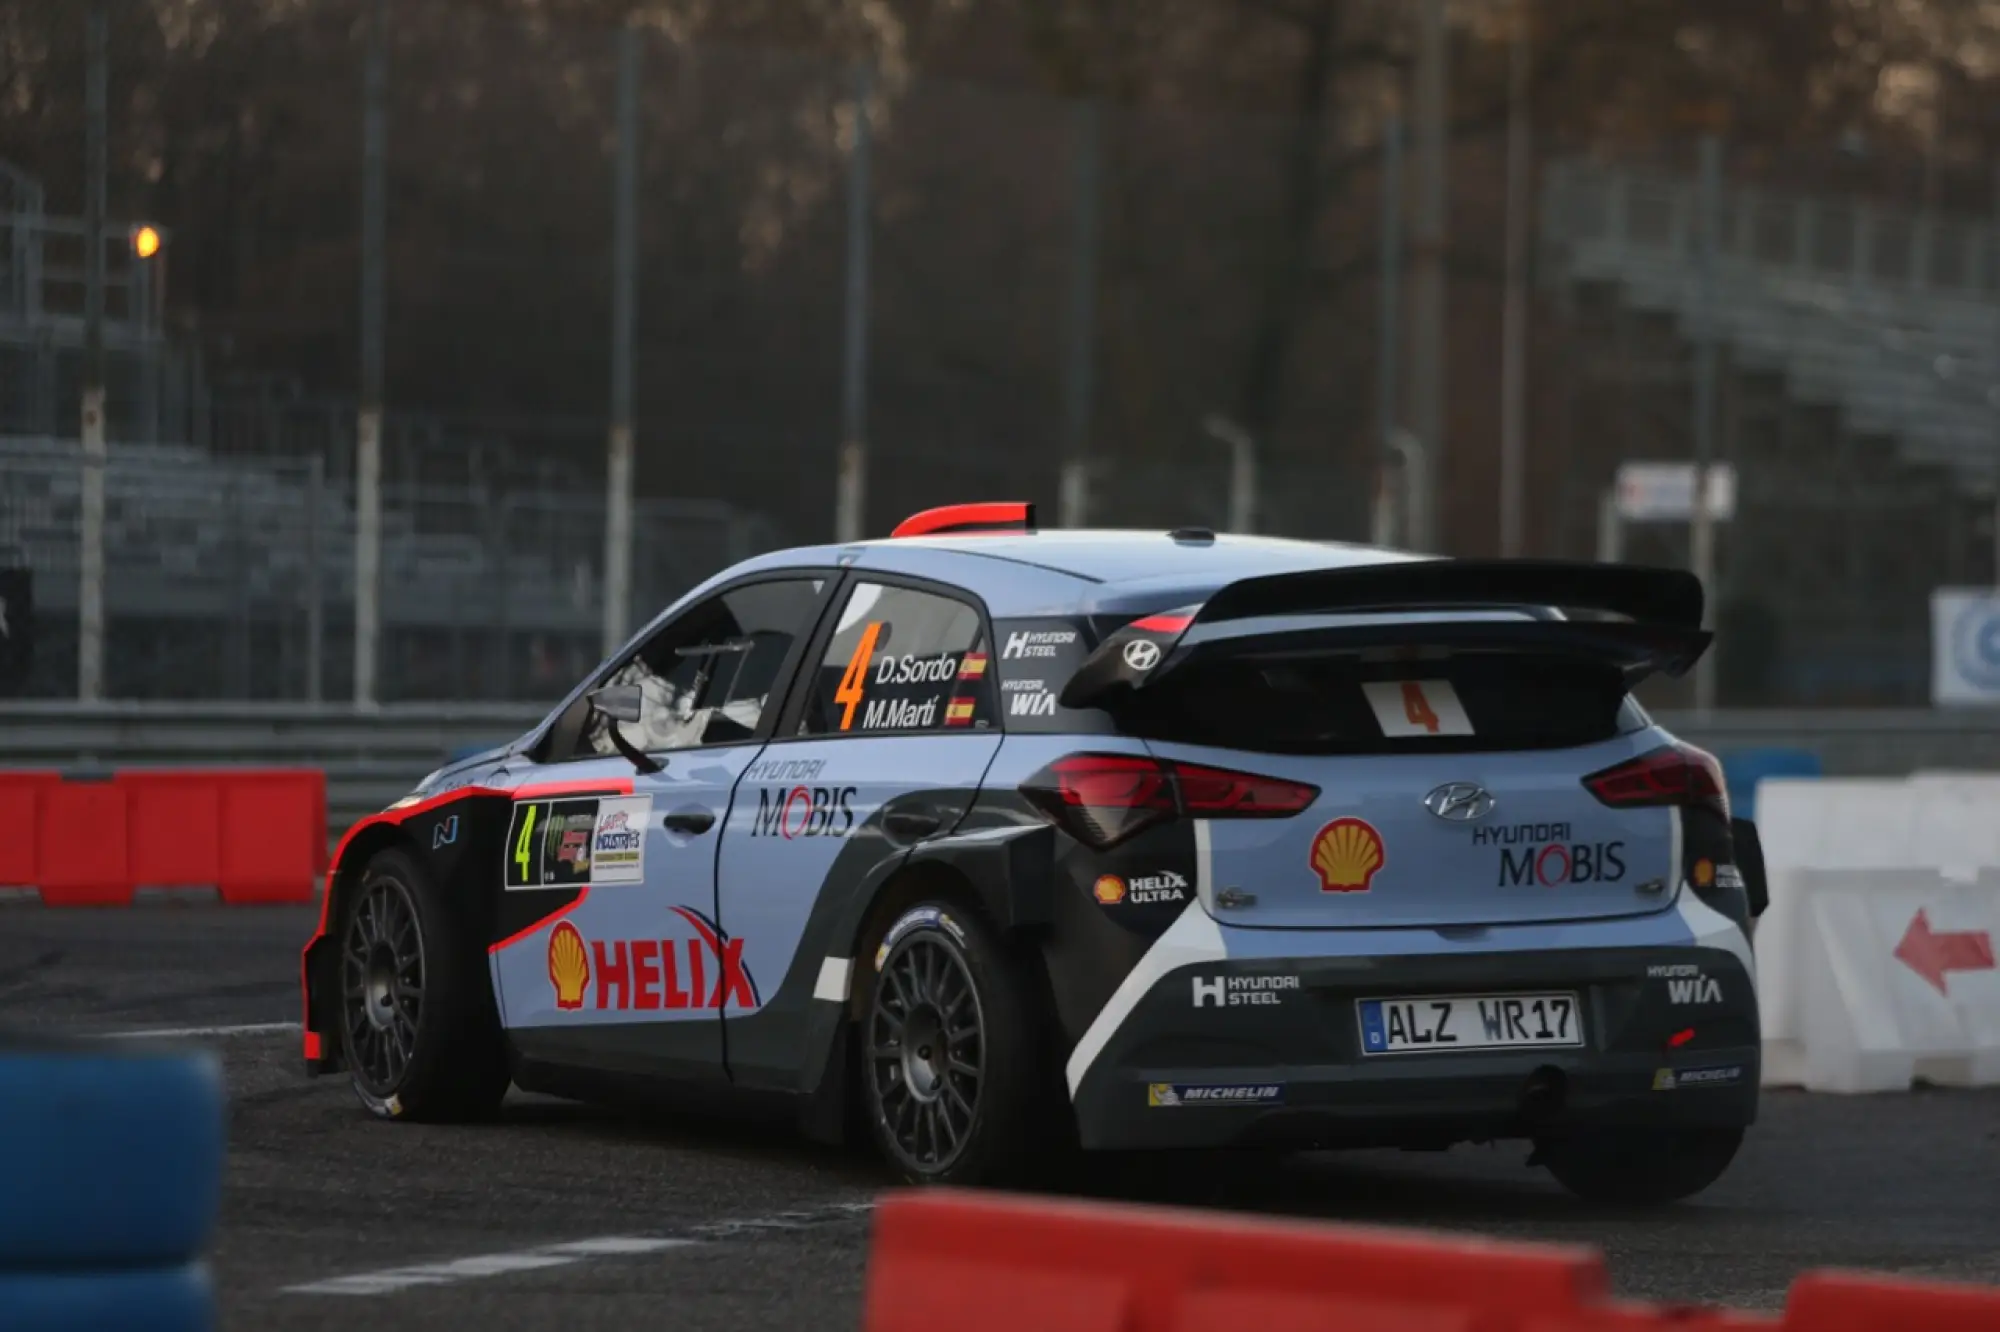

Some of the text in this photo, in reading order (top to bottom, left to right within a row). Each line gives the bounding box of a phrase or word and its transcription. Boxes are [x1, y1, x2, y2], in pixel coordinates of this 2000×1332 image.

[1027, 631, 1076, 644] HYUNDAI
[1023, 646, 1056, 657] STEEL
[835, 621, 956, 731] 4 D.Sordo
[1001, 680, 1044, 691] HYUNDAI
[862, 695, 940, 730] M.Martí
[1402, 682, 1440, 734] 4
[745, 760, 827, 780] HYUNDAI
[751, 784, 857, 840] MOBIS
[515, 805, 537, 882] 4
[1472, 822, 1571, 845] HYUNDAI
[1498, 841, 1626, 887] MOBIS
[1128, 870, 1188, 890] HELIX
[1130, 888, 1184, 904] ULTRA
[591, 906, 755, 1010] HELIX
[1647, 964, 1699, 977] HYUNDAI
[1228, 975, 1299, 989] HYUNDAI
[1228, 992, 1281, 1005] STEEL
[1388, 1002, 1458, 1044] ALZ
[1184, 1086, 1280, 1099] MICHELIN
